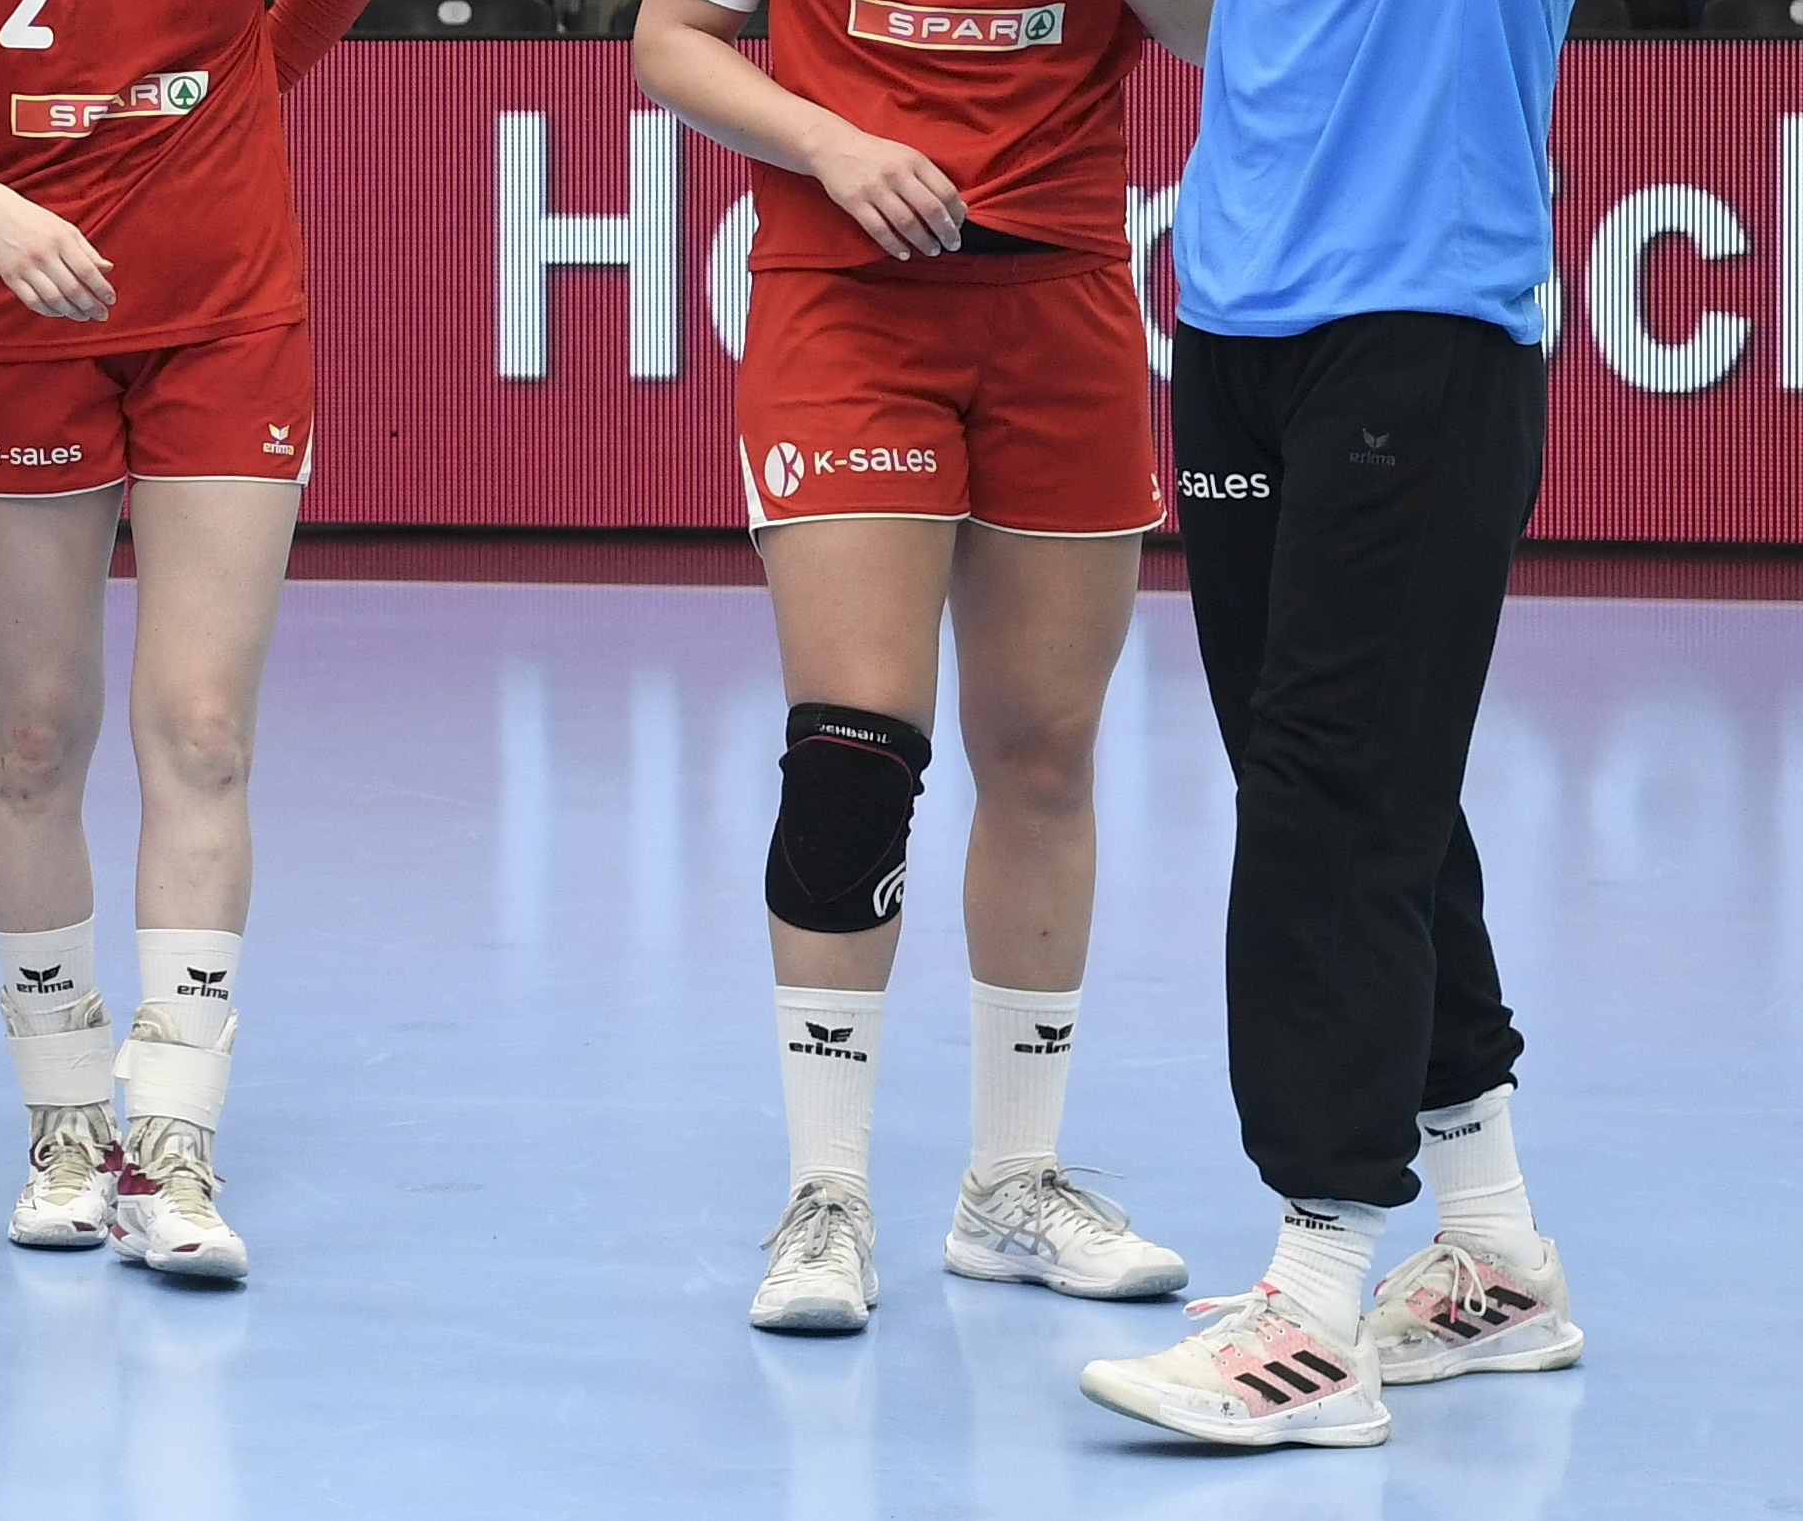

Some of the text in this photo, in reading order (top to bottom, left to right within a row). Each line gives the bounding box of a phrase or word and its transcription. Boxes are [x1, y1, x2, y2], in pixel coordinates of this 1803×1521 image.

[886, 10, 1019, 41] SPAR
[15, 978, 74, 995] erima
[176, 983, 229, 1001] erima
[787, 1041, 868, 1063] erima
